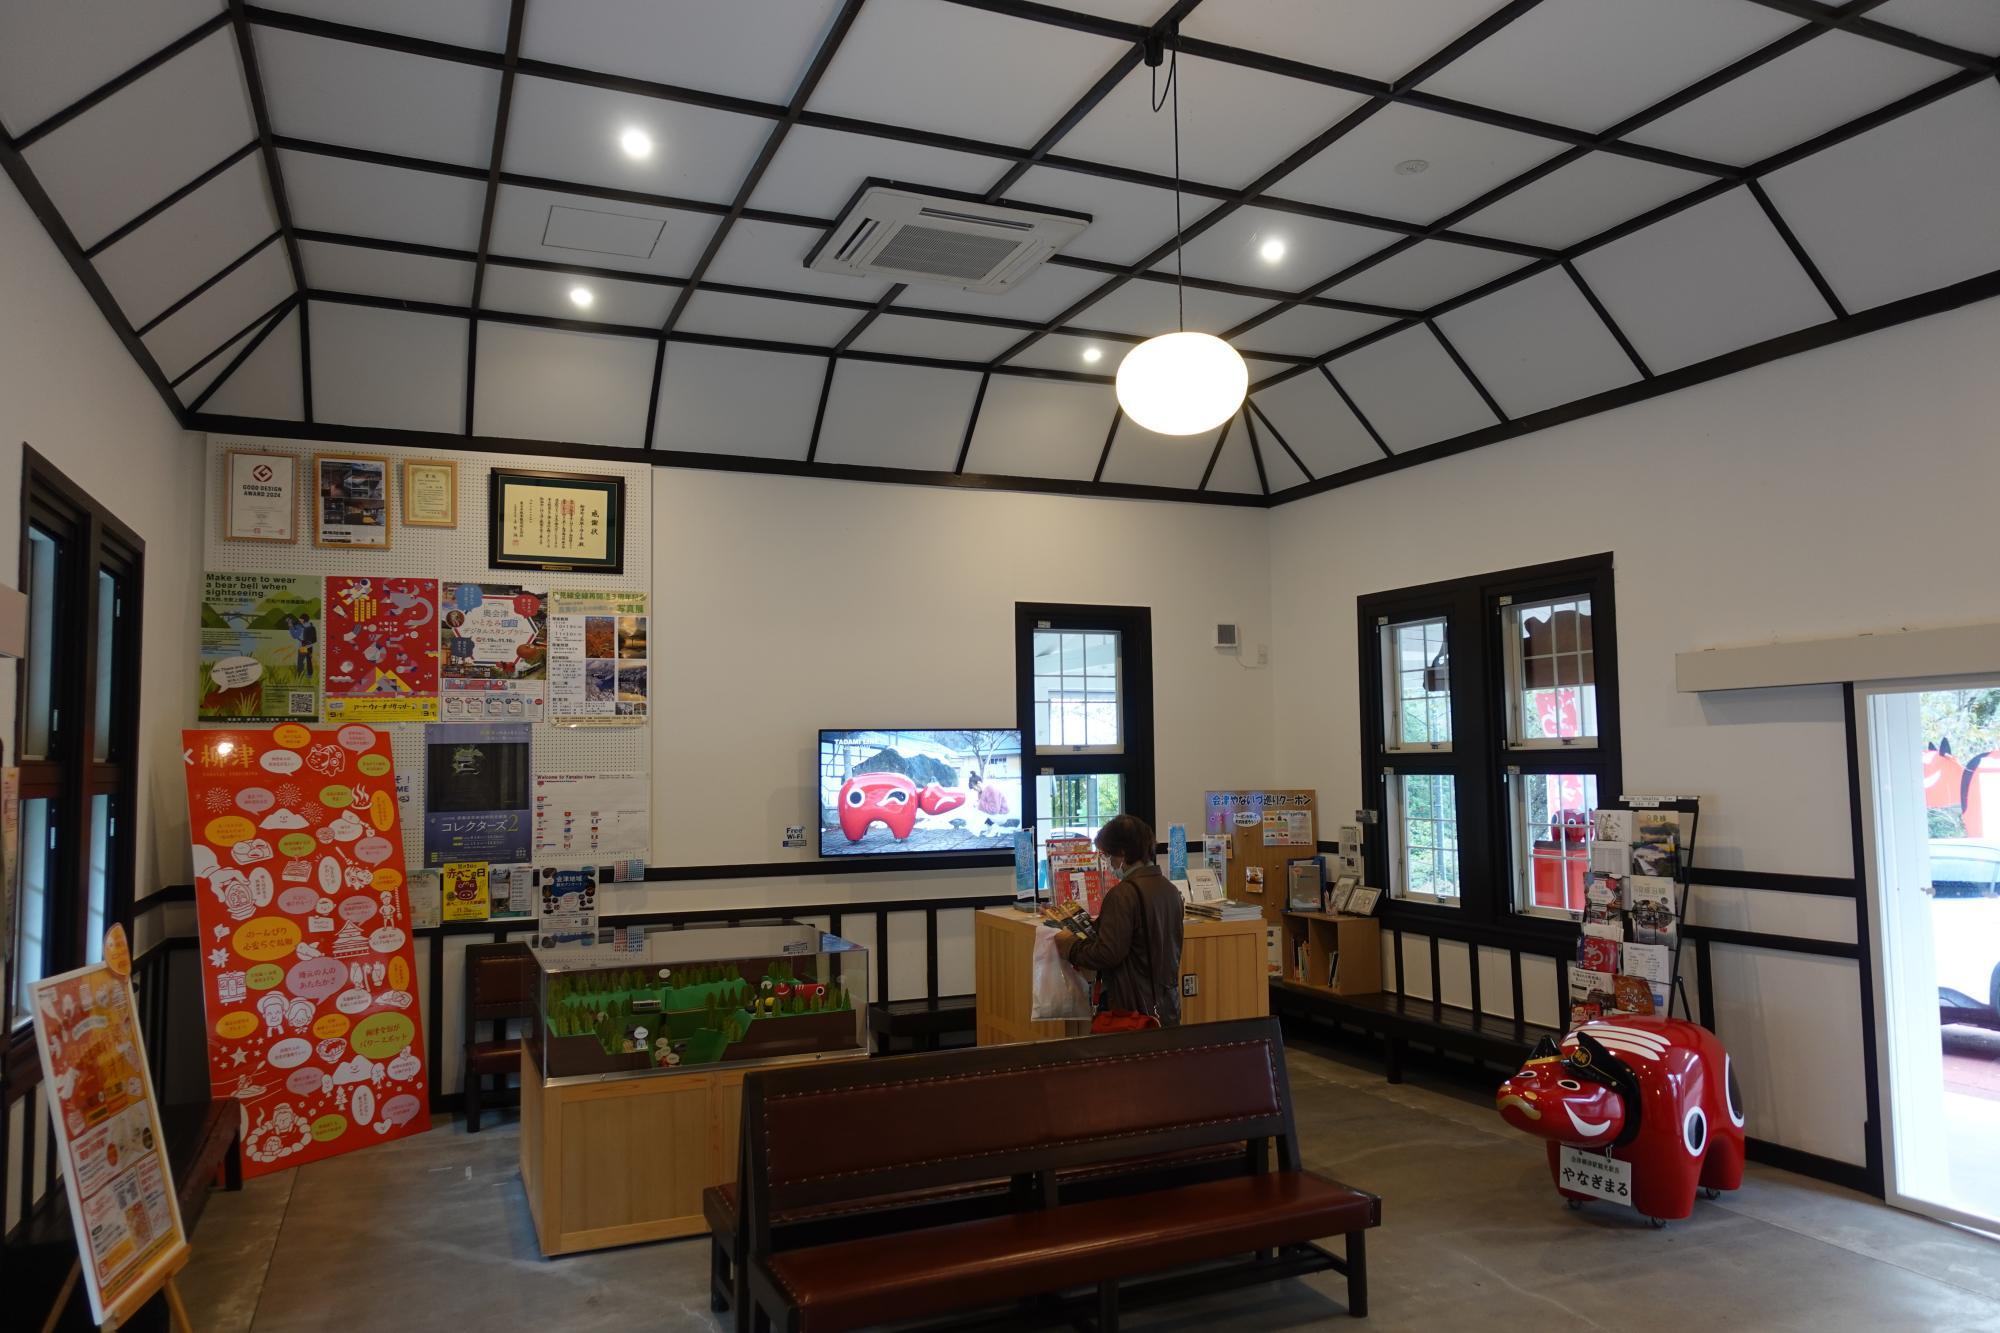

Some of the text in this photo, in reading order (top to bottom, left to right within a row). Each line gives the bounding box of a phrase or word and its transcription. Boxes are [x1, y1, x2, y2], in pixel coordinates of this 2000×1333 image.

[590, 509, 600, 535] 感謝状
[260, 575, 270, 583] to
[215, 581, 238, 589] bear
[240, 582, 258, 590] bell
[262, 583, 288, 591] when
[205, 588, 264, 599] sightseeing
[483, 609, 509, 618] 奥会津
[616, 604, 644, 614] 写真展
[360, 1032, 408, 1048] パワースポット
[1562, 1167, 1628, 1197] やなぎまる
